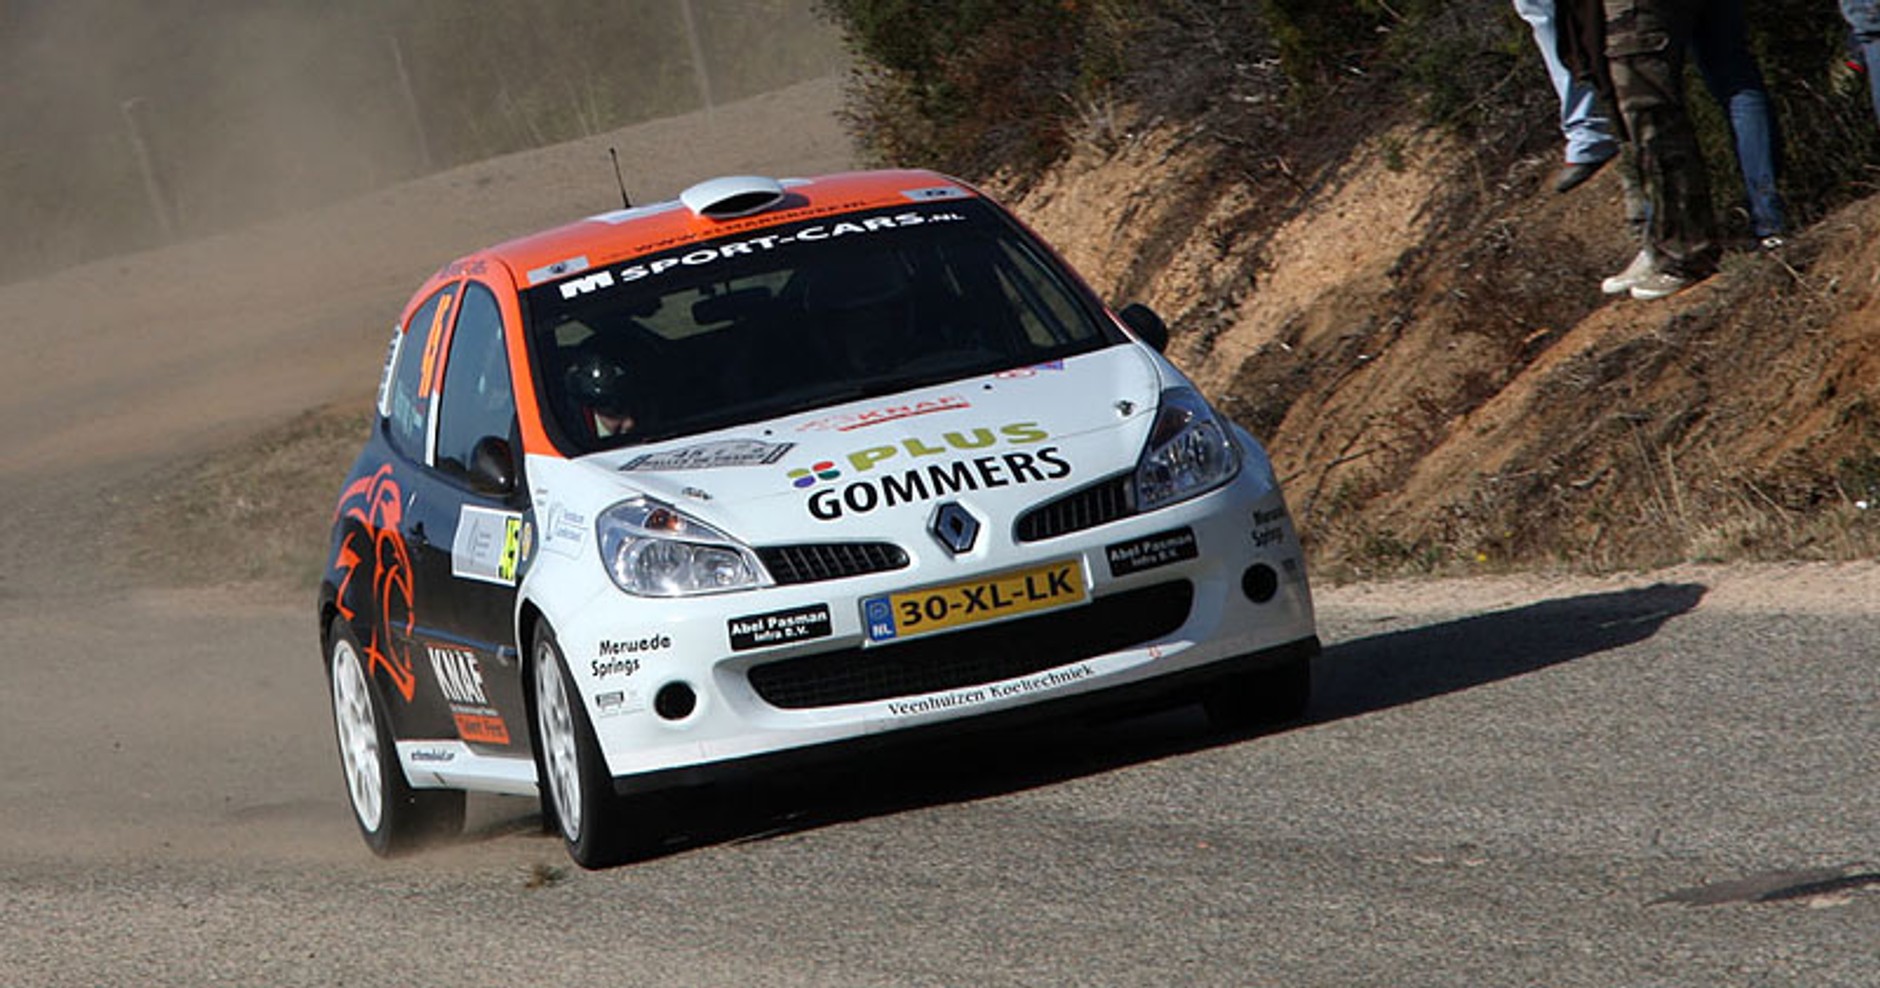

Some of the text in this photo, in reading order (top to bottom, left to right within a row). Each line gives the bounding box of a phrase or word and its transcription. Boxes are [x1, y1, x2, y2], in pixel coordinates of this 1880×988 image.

[618, 211, 967, 282] SPORT-CARS.NL
[847, 422, 1049, 472] PLUS
[807, 447, 1072, 520] GOMMERS
[899, 568, 1075, 627] 30-XL-LK
[599, 633, 671, 657] Merwede
[731, 611, 828, 636] Abel Pasman
[872, 623, 894, 638] NL
[427, 647, 488, 704] KNAF
[591, 657, 640, 679] Springs
[888, 664, 1095, 716] Veenhuizen Koeltechniek
